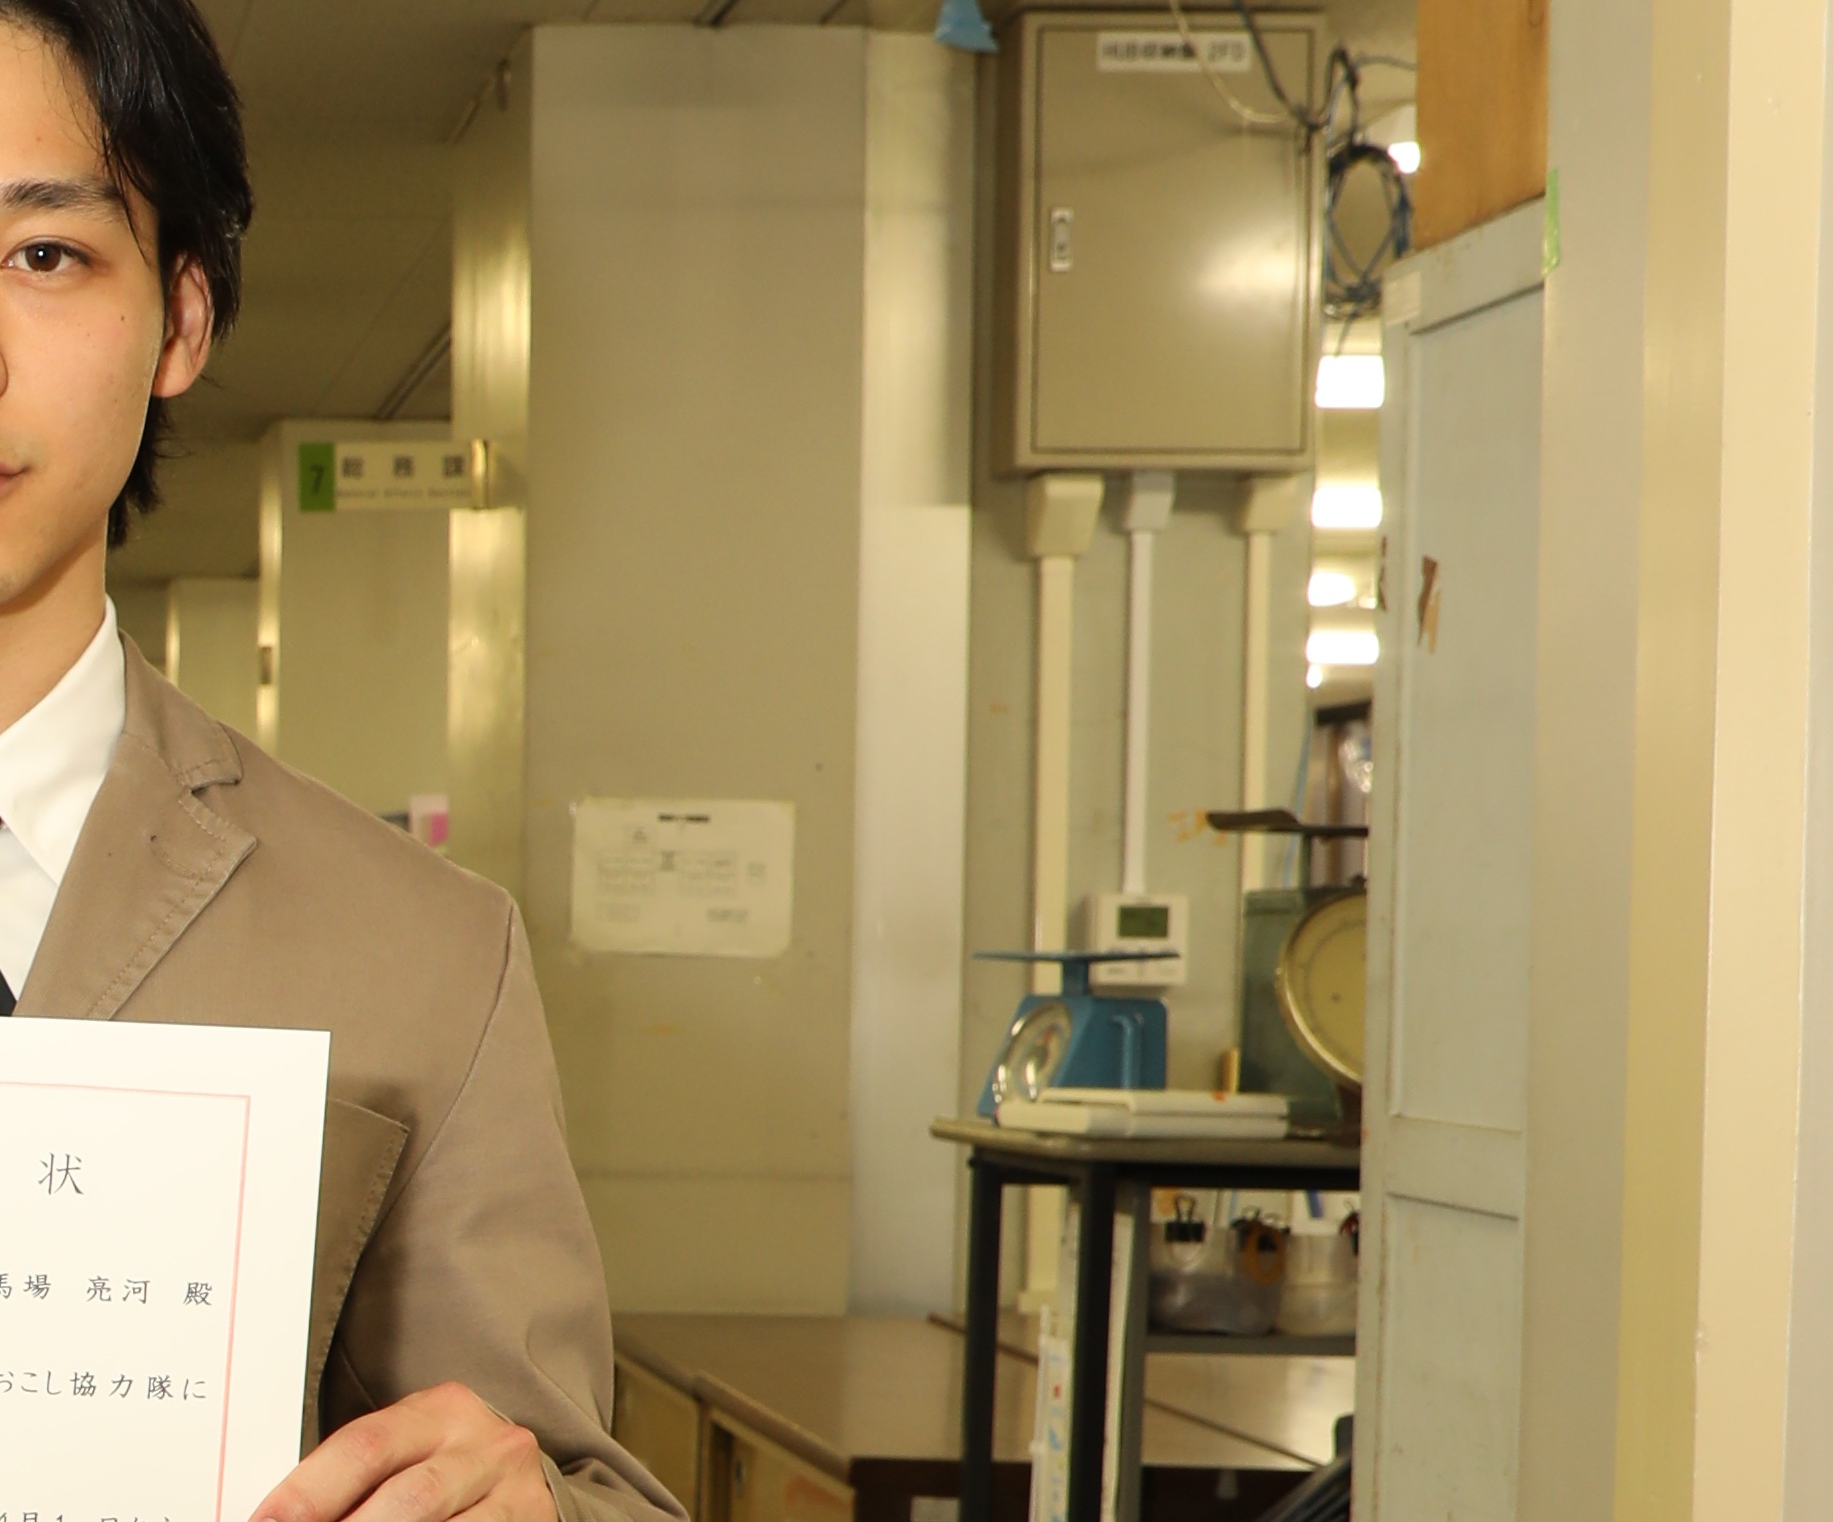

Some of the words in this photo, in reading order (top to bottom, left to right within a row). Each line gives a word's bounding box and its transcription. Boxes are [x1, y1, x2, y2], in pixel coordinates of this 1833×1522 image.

[310, 464, 325, 495] 7
[85, 1274, 152, 1306] 亮河
[182, 1281, 214, 1307] 殿
